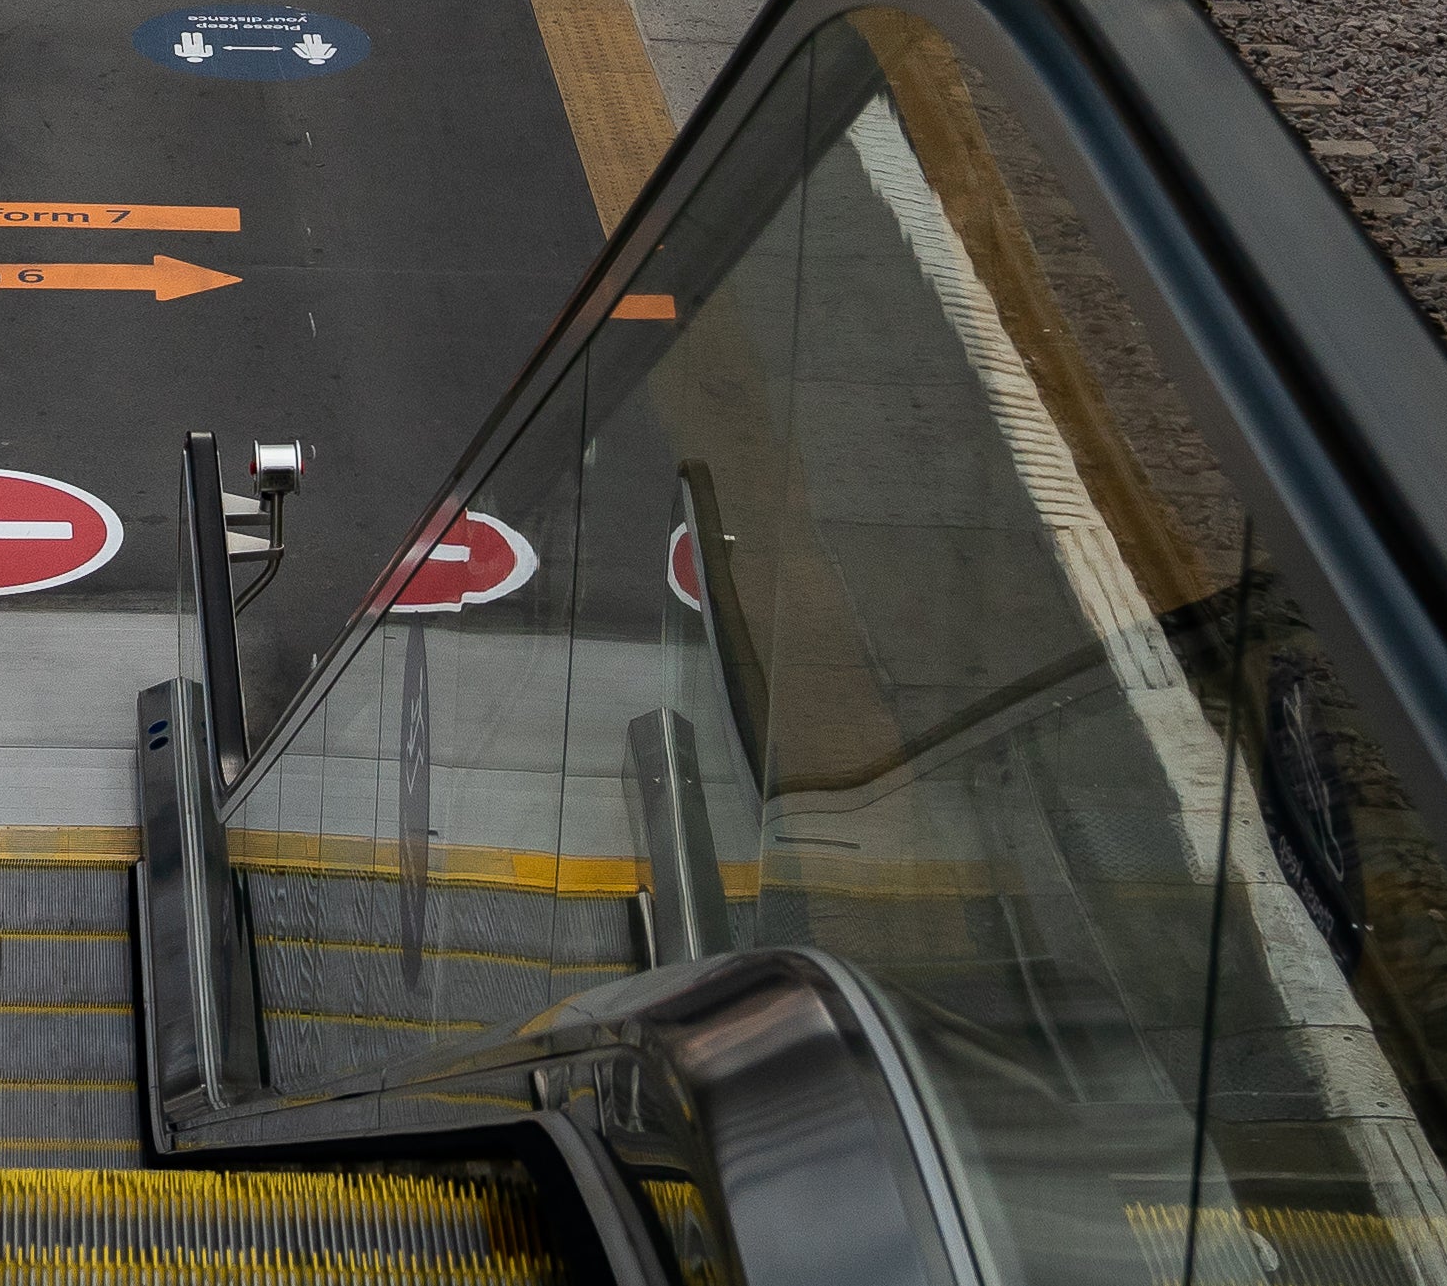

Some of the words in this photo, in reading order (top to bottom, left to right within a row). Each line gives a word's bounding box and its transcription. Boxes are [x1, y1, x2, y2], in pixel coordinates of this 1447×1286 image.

[187, 15, 263, 23] distance
[266, 15, 308, 23] your
[196, 22, 239, 30] keep
[242, 23, 301, 31] Please
[106, 209, 132, 224] 7
[18, 269, 45, 283] 6
